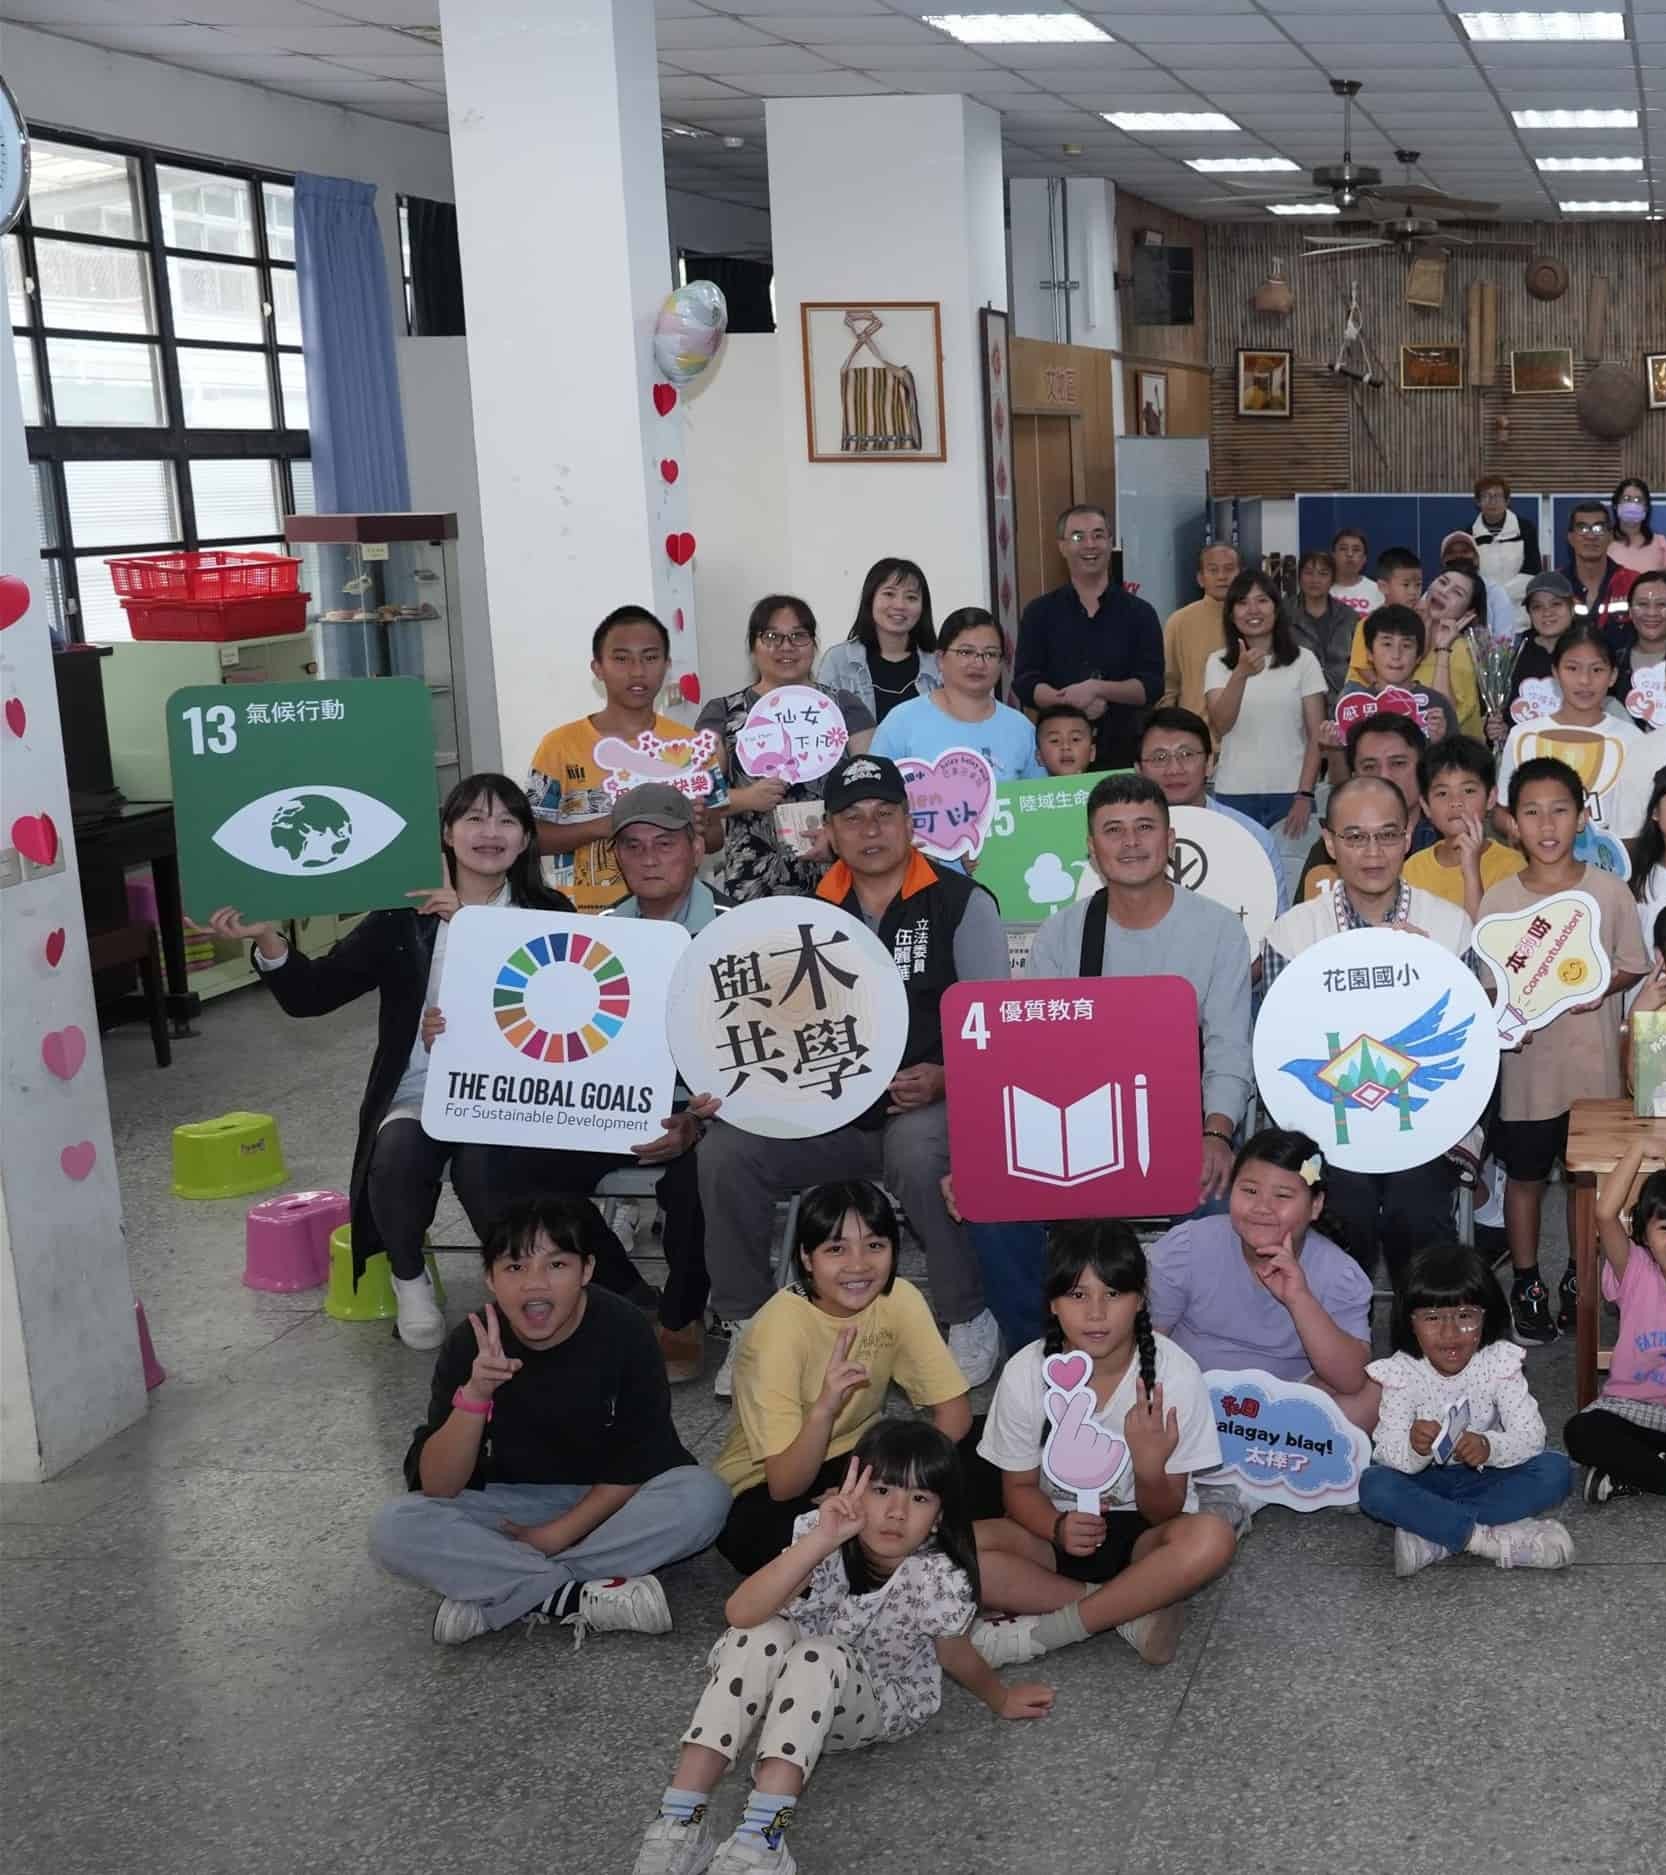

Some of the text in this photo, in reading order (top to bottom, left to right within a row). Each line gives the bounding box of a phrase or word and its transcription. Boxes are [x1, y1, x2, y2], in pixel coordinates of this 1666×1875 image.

[245, 698, 345, 725] 氣候行動
[774, 705, 821, 726] 仙女
[182, 704, 238, 755] 13
[794, 734, 833, 749] 下凡
[1018, 788, 1091, 813] 陸域生命
[912, 917, 929, 974] 立法委員
[1522, 908, 1586, 996] Congratulation!
[1322, 962, 1421, 993] 花園國小
[1000, 998, 1095, 1023] 優質教育
[960, 1001, 992, 1051] 4
[449, 1071, 654, 1114] THE GLOBAL GOALS
[445, 1102, 649, 1132] For Sustainable Development
[1216, 1420, 1334, 1456] alagay blaq!
[1244, 1446, 1310, 1472] 太棒了
